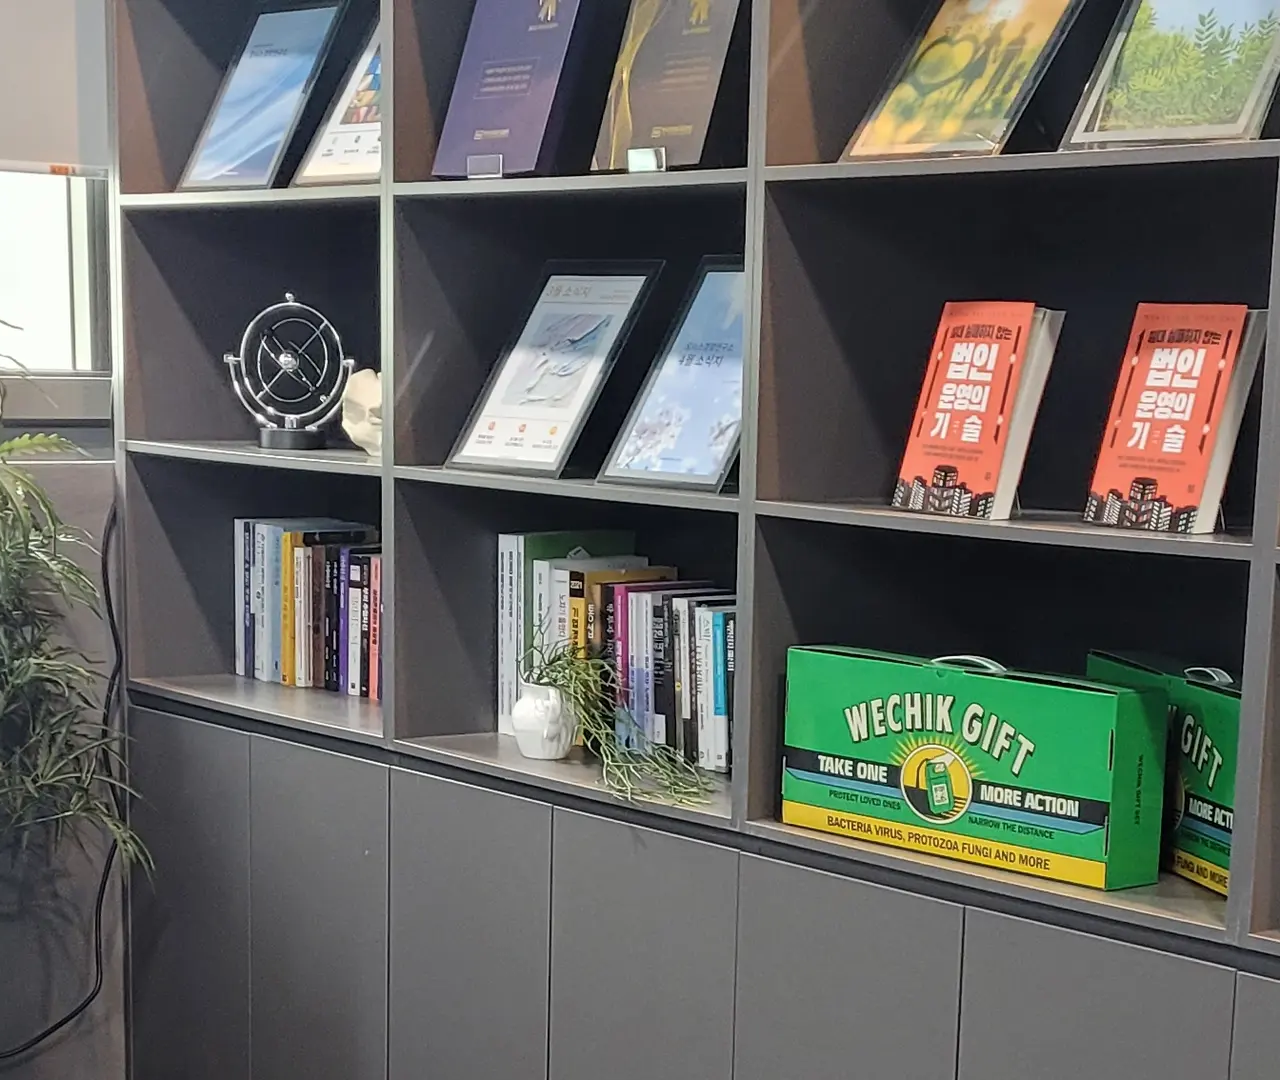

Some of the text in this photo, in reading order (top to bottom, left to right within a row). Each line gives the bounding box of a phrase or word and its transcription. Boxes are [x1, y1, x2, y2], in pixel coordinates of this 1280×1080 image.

[946, 342, 1000, 381] 법인
[1145, 347, 1207, 389] 법인
[937, 382, 991, 413] 운영의
[1135, 390, 1196, 421] 운영의
[843, 692, 1036, 778] WECHIK GIFT
[818, 754, 888, 783] TAKE ONE
[1180, 713, 1224, 793] GIFT
[828, 789, 901, 811] PROTECT LOVED ONES
[980, 784, 1080, 818] MORE ACTION
[1188, 797, 1213, 822] MORE
[827, 815, 1051, 871] BACTERIA VIRUS, PROTOZOA FUNGI AND MORE
[968, 816, 1055, 840] NARROW THE DISTANCE
[1196, 863, 1209, 879] AND
[1209, 868, 1228, 888] MORE
